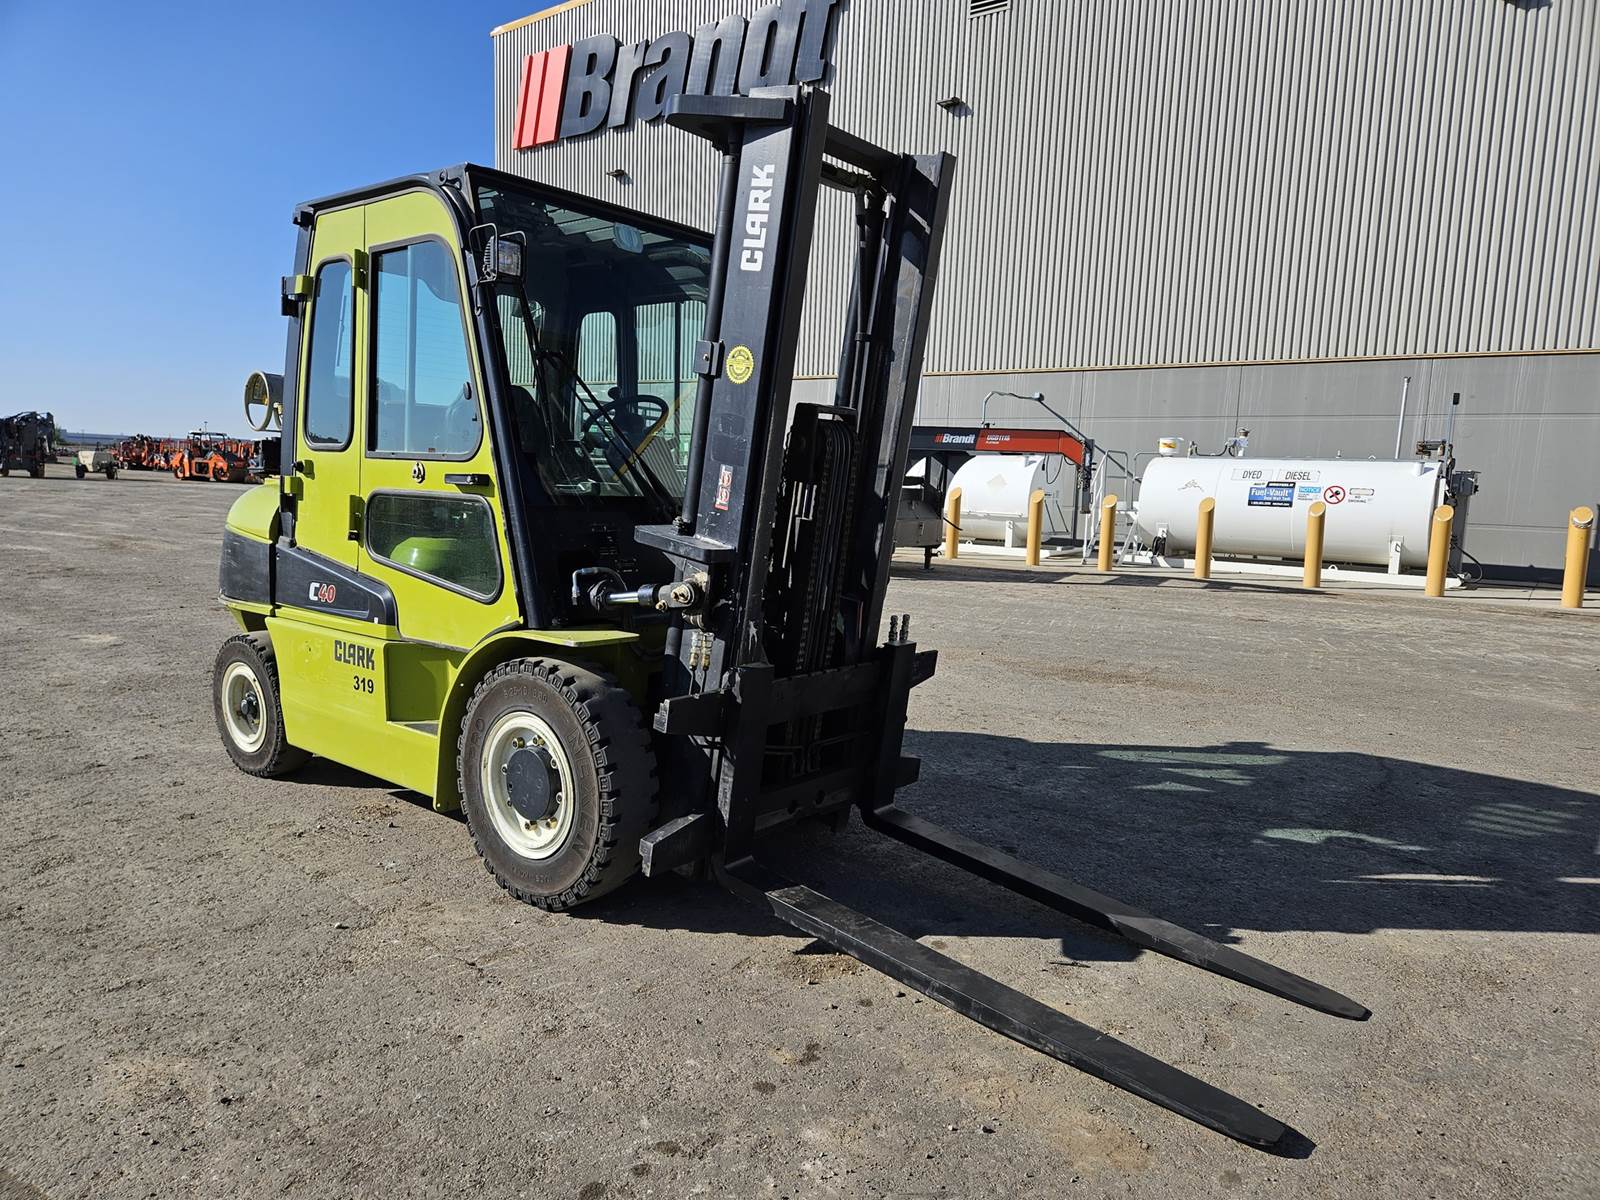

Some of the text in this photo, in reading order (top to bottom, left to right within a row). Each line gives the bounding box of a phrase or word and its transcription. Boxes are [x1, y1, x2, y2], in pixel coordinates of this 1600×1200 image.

[559, 0, 836, 140] Brandt
[740, 163, 776, 272] CLARK
[942, 434, 976, 443] Brandt
[1242, 470, 1312, 480] DYED DIESEL
[309, 582, 336, 603] C40
[334, 640, 375, 671] CLARK
[353, 675, 374, 694] 319
[567, 727, 594, 857] NEXEN
